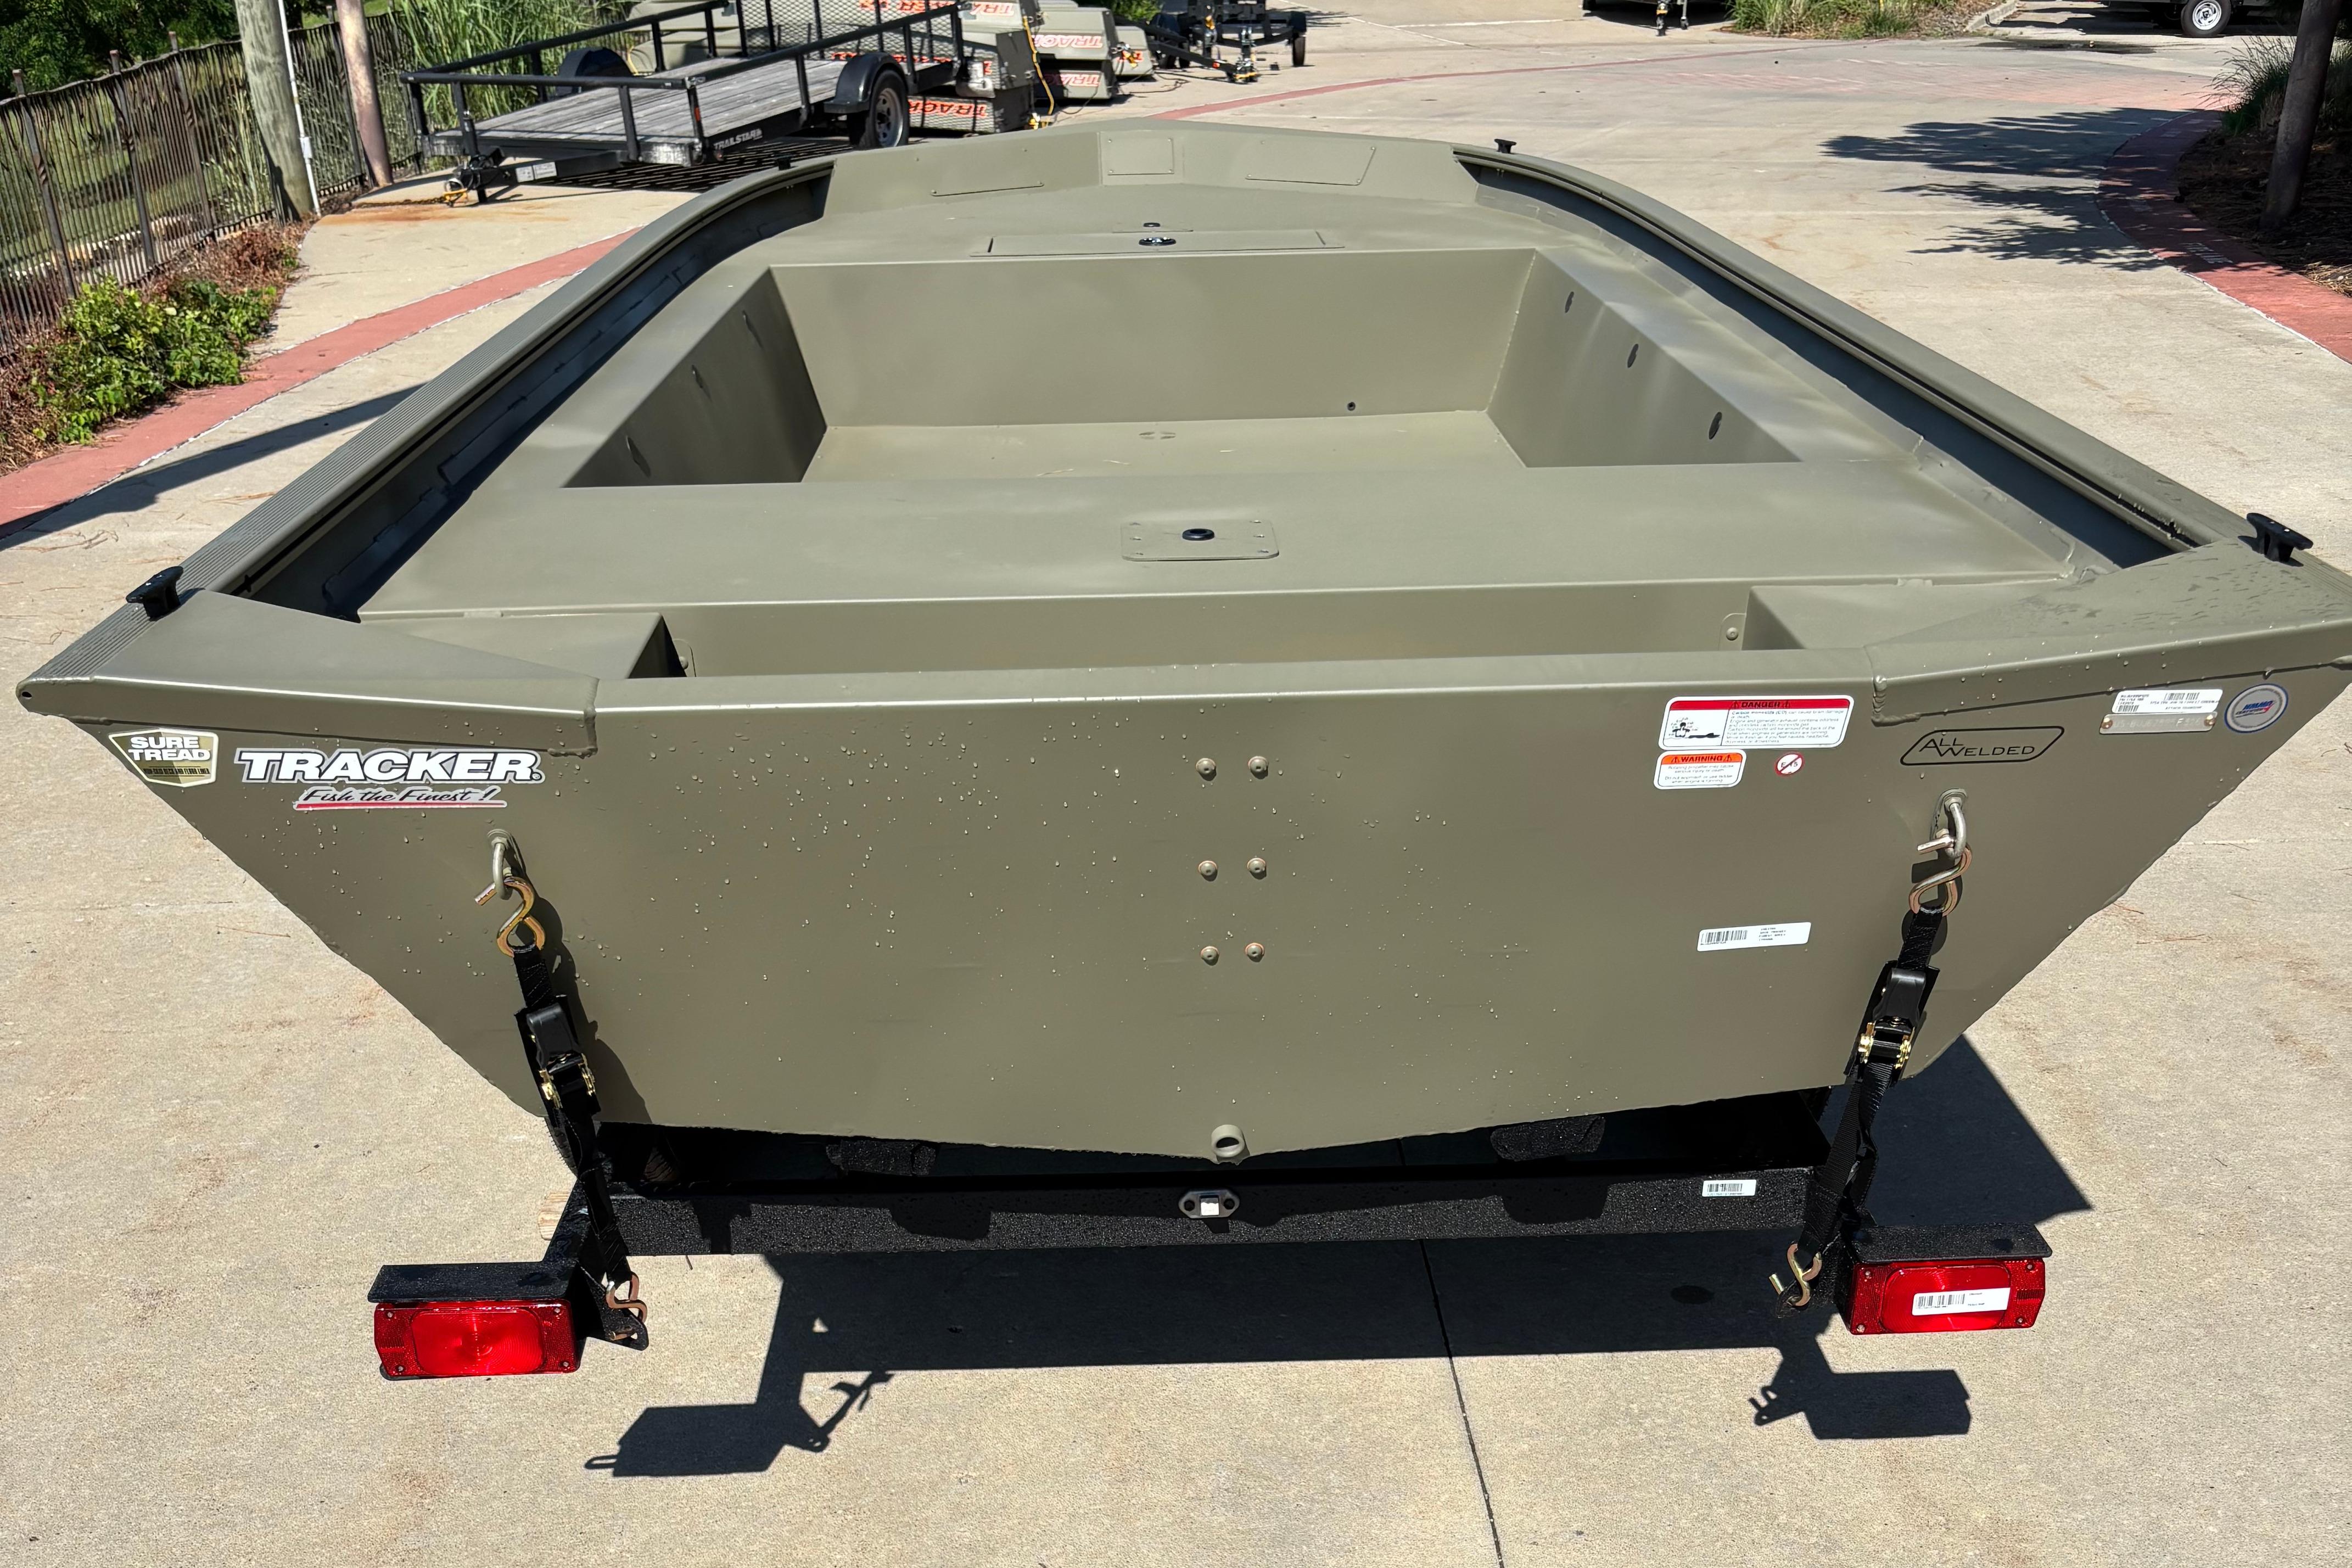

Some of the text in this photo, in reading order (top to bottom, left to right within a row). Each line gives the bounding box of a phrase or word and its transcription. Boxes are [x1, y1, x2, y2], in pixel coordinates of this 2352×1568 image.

[130, 736, 199, 749] SURE
[1919, 738, 1964, 752] ALL
[128, 749, 210, 761] TREAD
[1936, 746, 2035, 757] WELDED
[303, 789, 355, 801] Fish
[359, 790, 396, 801] the
[399, 789, 479, 801] Finest
